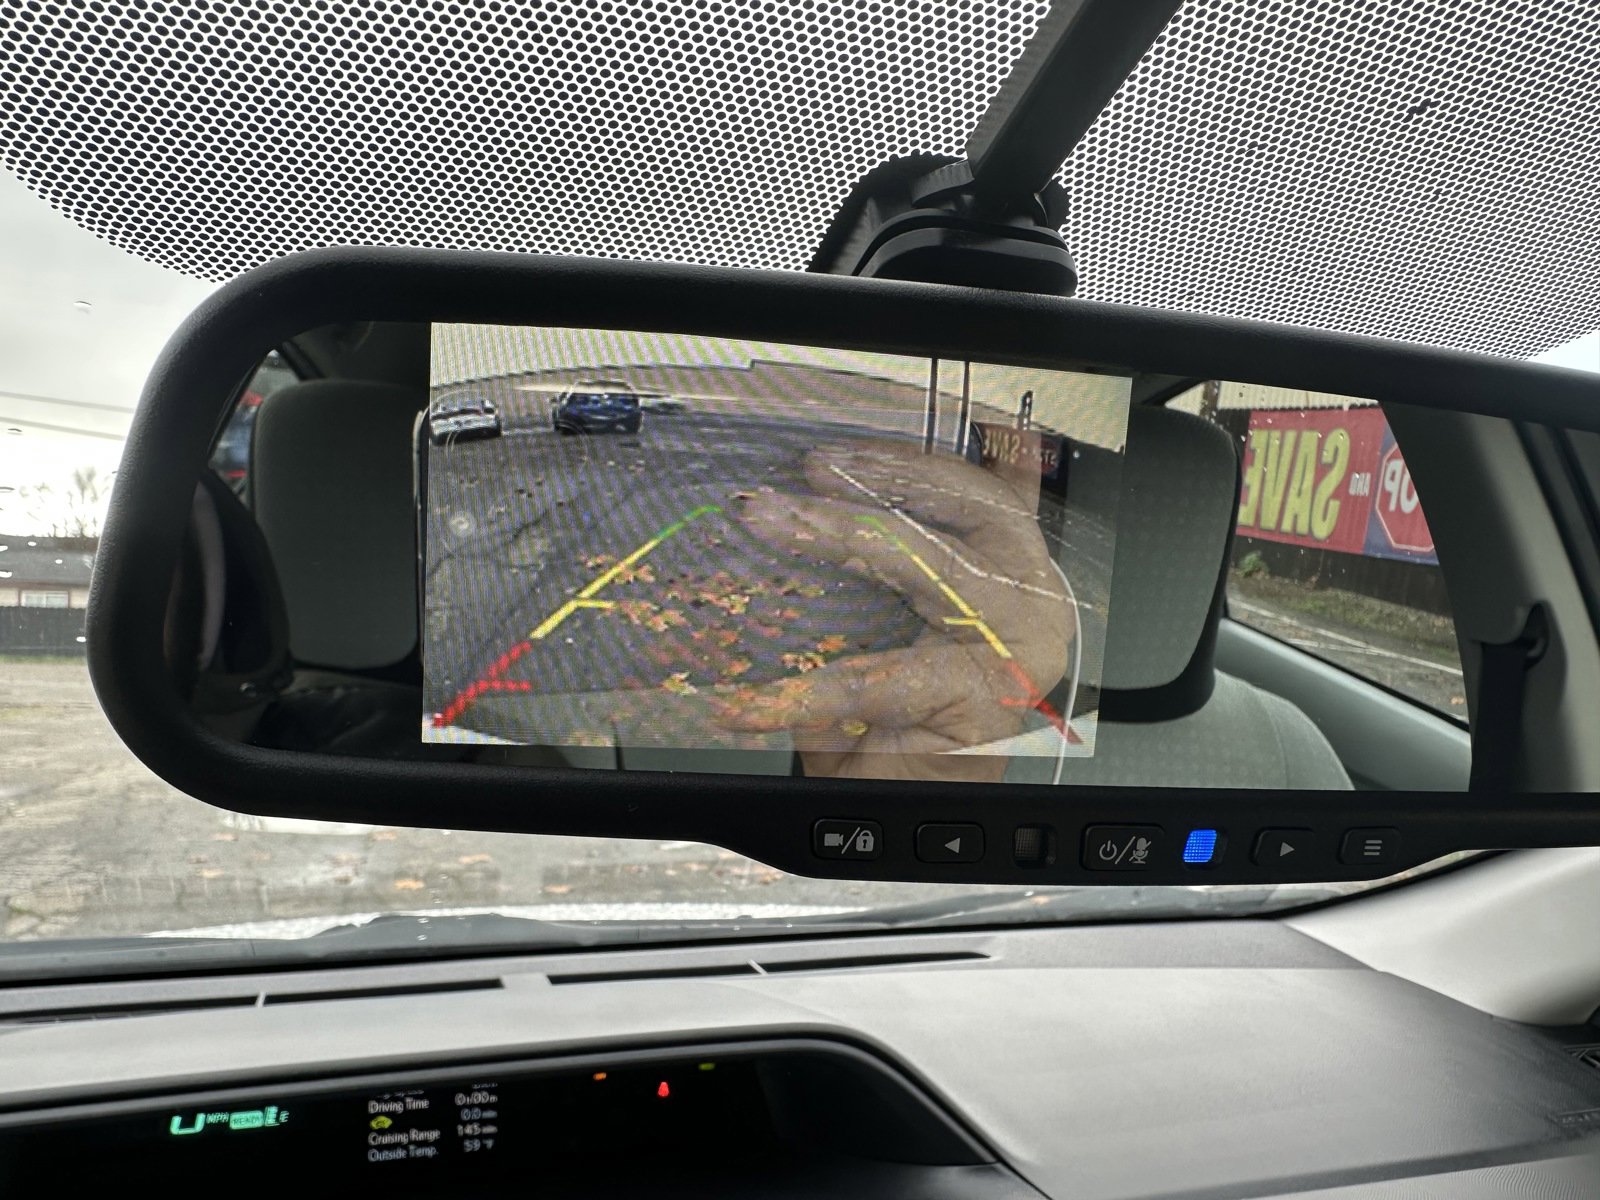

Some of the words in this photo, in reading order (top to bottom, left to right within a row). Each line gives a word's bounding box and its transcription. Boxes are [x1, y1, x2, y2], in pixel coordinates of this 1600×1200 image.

[368, 1100, 404, 1114] Driving
[405, 1097, 430, 1110] Time
[368, 1132, 409, 1146] Cruising
[409, 1128, 441, 1142] Range
[368, 1148, 407, 1162] Outside
